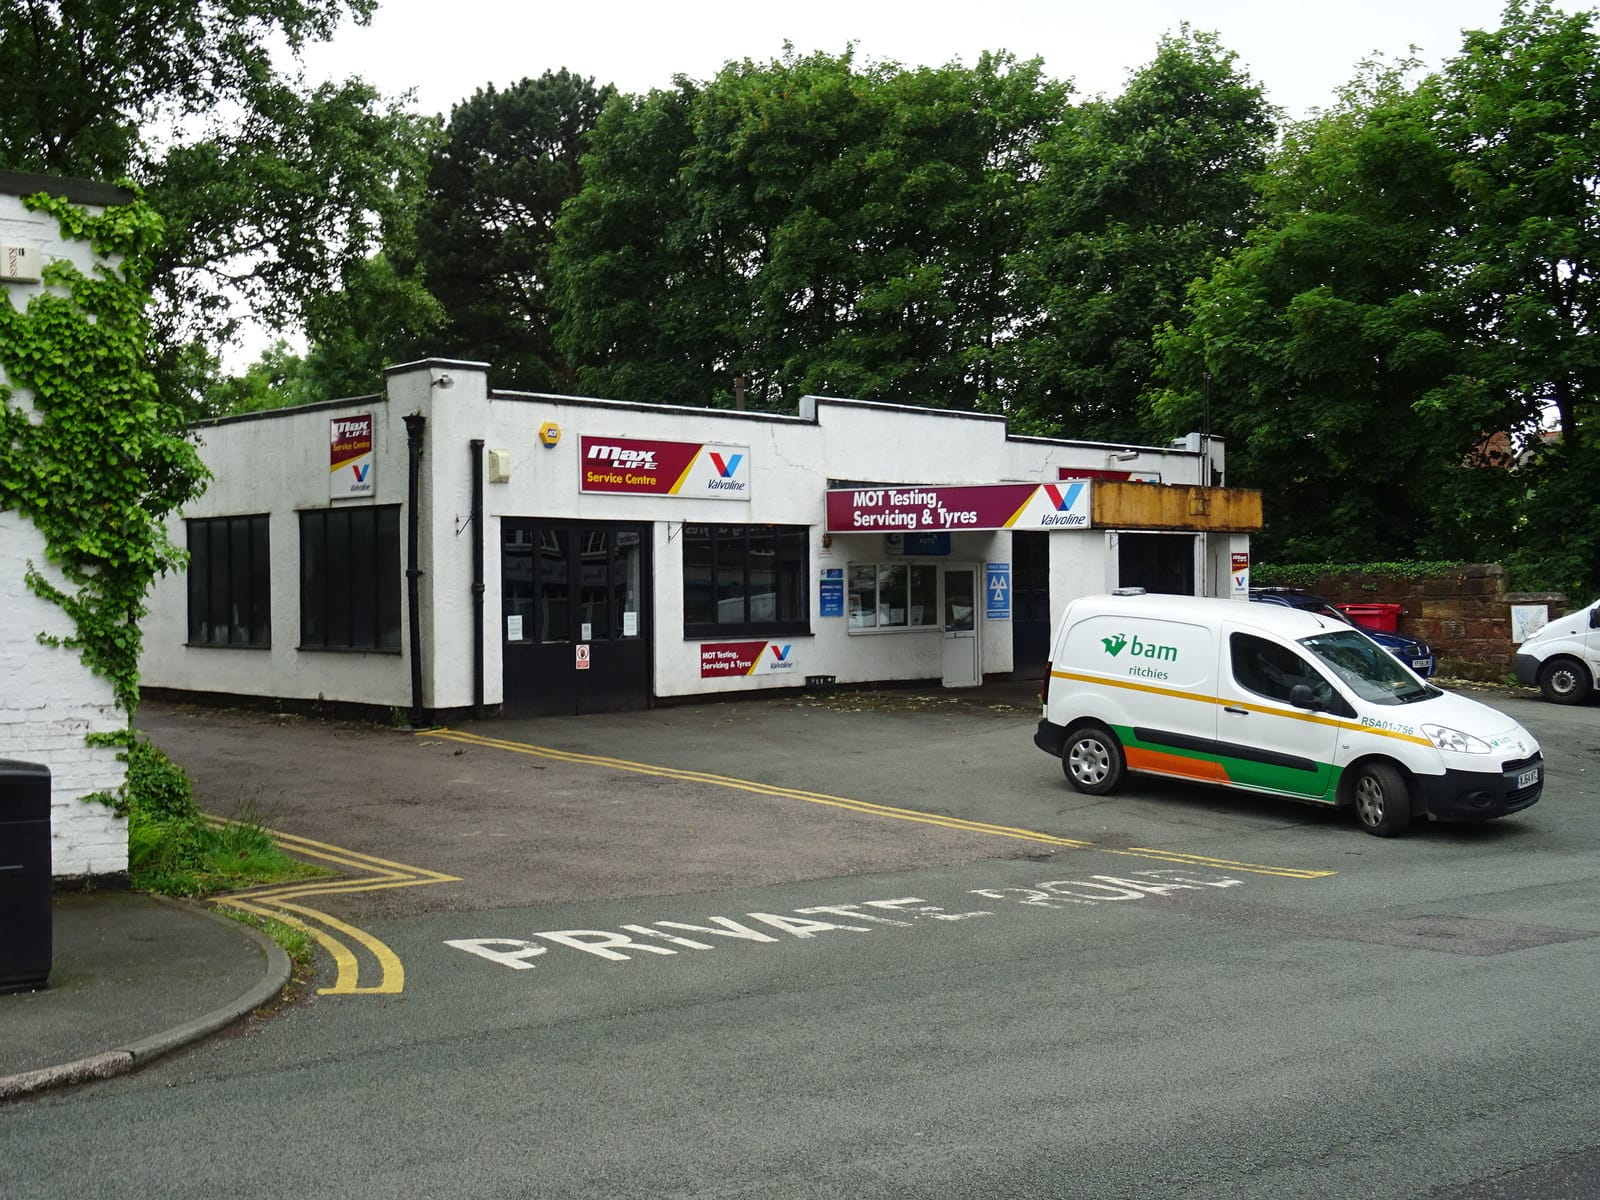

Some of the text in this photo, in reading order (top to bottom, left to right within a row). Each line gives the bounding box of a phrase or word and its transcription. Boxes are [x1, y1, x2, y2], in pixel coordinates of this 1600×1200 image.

[612, 460, 659, 470] LIFE
[587, 471, 657, 486] Service Centre
[707, 479, 745, 491] Valvoline
[853, 489, 943, 509] MOT Testing,
[853, 508, 977, 528] Servicing & Tyres
[1041, 514, 1086, 526] Valvoline
[702, 651, 716, 660] MOT
[1130, 635, 1178, 662] bam
[702, 662, 729, 670] Servicing
[736, 660, 752, 669] Tyres
[1129, 665, 1168, 680] ritchies
[1361, 716, 1414, 735] RSA01-756
